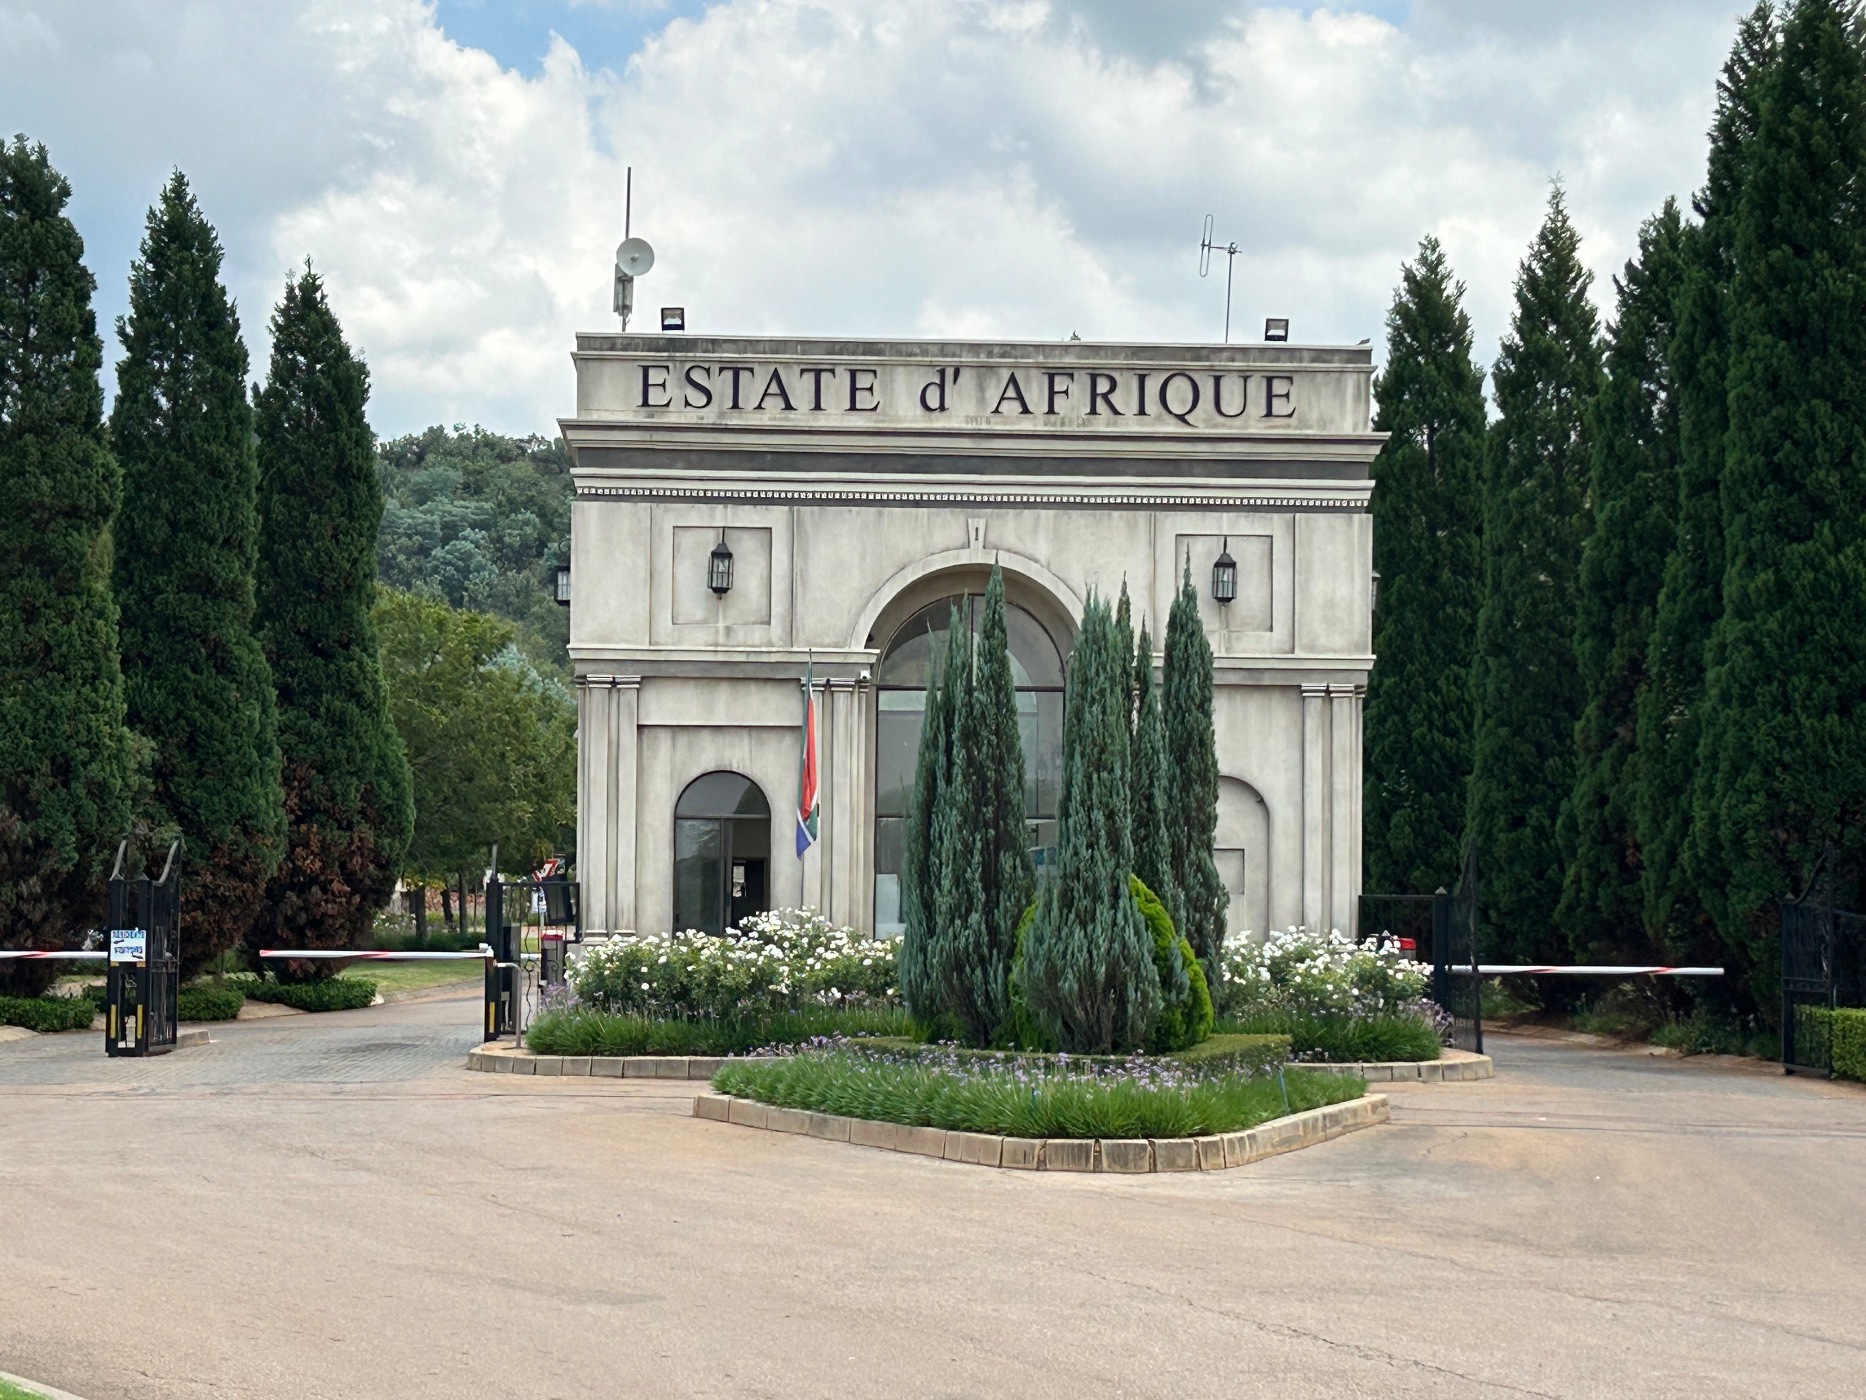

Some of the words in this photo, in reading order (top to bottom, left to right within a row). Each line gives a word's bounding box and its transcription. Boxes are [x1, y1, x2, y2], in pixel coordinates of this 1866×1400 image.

[636, 364, 881, 412] ESTATE
[920, 366, 962, 413] d'
[990, 371, 1297, 425] AFRIQUE
